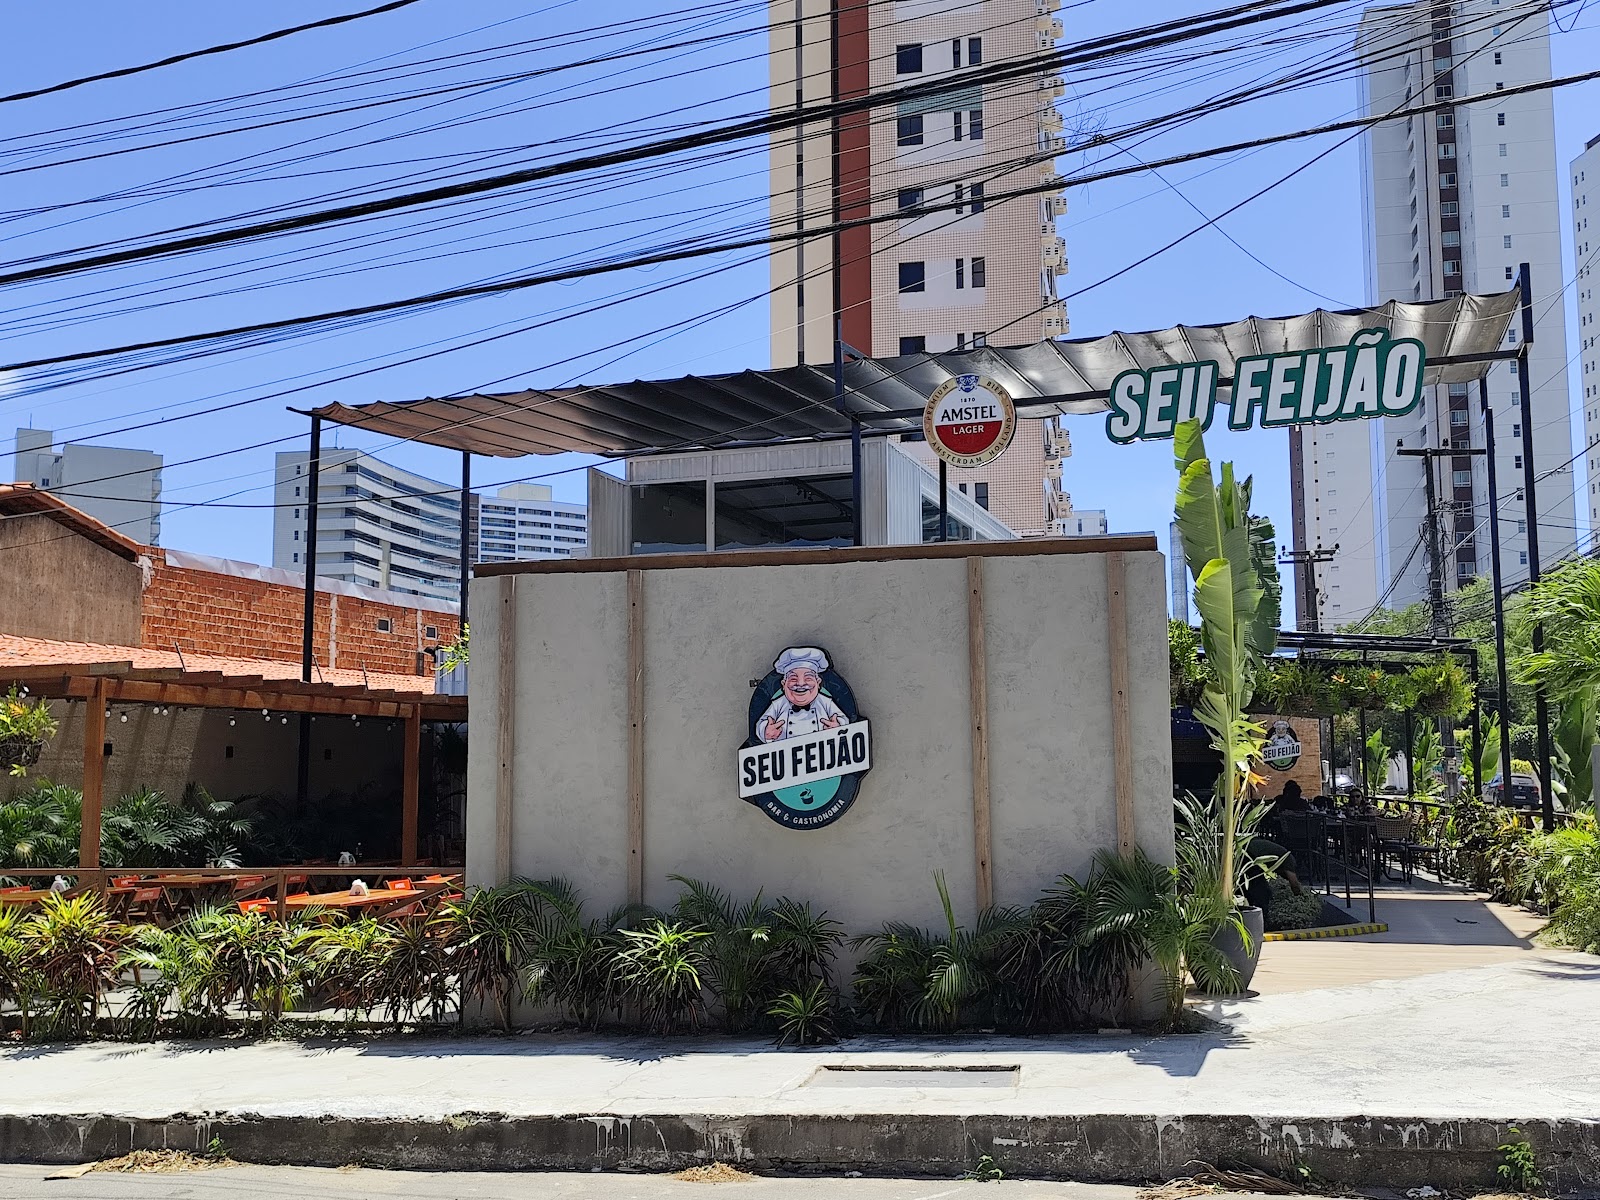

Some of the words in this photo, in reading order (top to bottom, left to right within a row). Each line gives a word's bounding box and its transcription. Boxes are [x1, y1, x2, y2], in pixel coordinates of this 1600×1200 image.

[926, 384, 949, 421] PREMIUM
[986, 381, 1003, 396] BIER
[1110, 363, 1213, 439] SEU
[1232, 332, 1420, 425] FEIJÃO
[940, 405, 997, 422] AMSTEL
[953, 424, 984, 435] LAGER
[931, 441, 983, 465] AMSTERDAM
[988, 417, 1012, 457] HOLLAND
[743, 749, 785, 788] SEU
[791, 728, 866, 778] FEIJÃO
[1263, 748, 1277, 759] SEU
[1277, 743, 1300, 757] FEIJÃO
[767, 801, 782, 816] BAR
[792, 799, 846, 825] GASTRONOMIA
